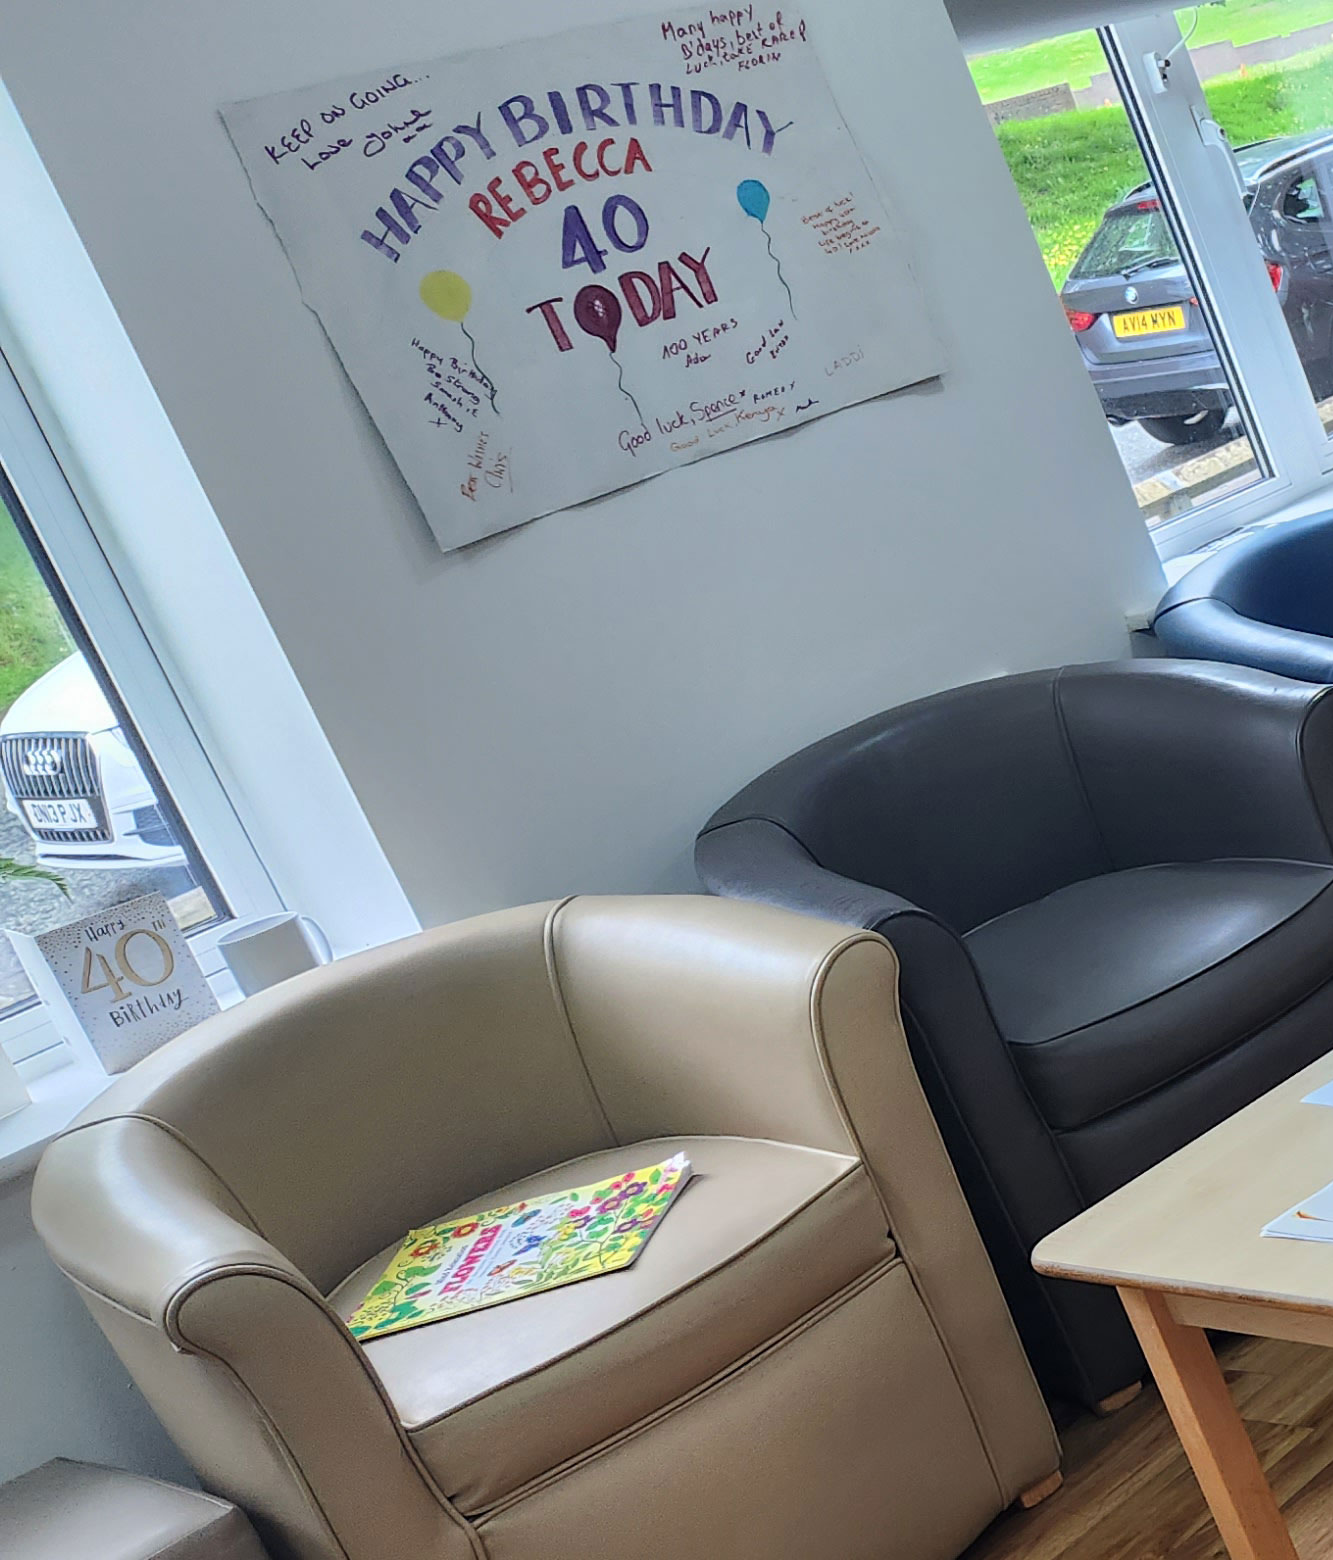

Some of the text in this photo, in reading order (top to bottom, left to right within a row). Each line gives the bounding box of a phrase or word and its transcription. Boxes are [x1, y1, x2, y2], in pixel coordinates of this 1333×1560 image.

[661, 4, 753, 41] Many happy
[264, 119, 314, 165] KEEP
[320, 105, 346, 124] ON
[360, 82, 795, 264] HAPPY BIRTHDAY
[468, 137, 653, 240] REBECCA
[561, 194, 650, 275] 40
[410, 337, 443, 365] Happy
[692, 317, 738, 345] YEARS
[1123, 311, 1176, 334] AV14 MYN
[618, 429, 651, 457] Good
[80, 928, 175, 1004] 40
[438, 1223, 503, 1296] FLOWERS
